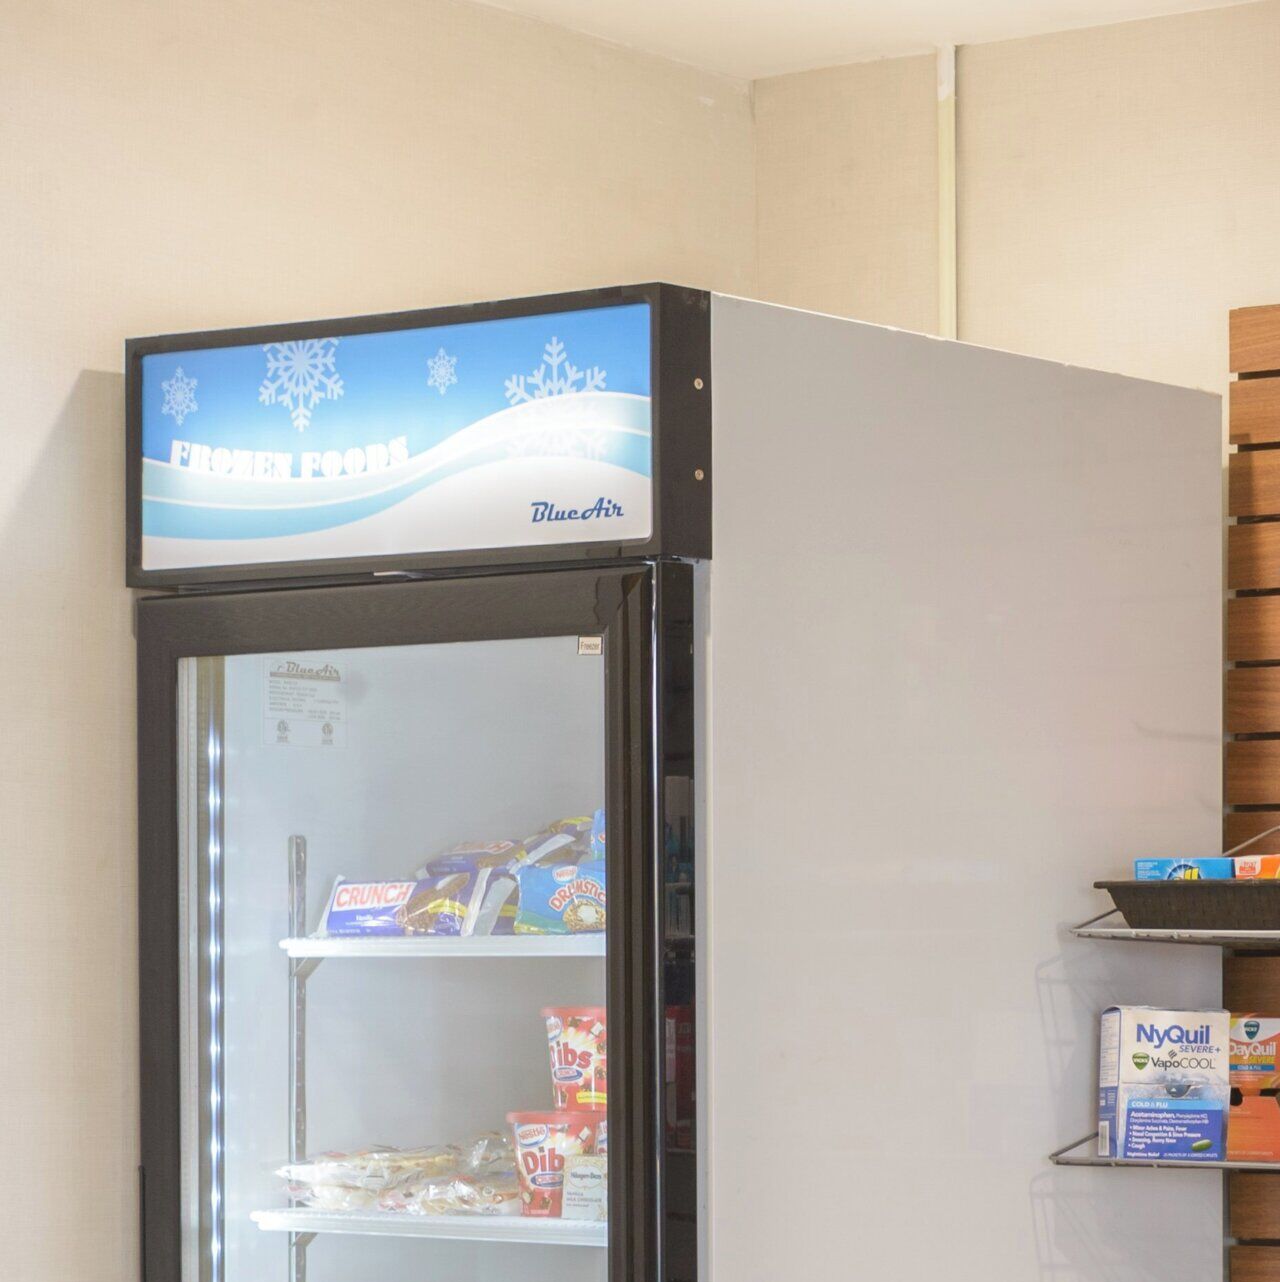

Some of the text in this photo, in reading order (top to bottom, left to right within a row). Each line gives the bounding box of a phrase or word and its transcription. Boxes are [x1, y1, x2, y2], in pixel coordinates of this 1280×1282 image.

[170, 436, 409, 478] FROZEN FOODS
[335, 883, 411, 907] CRUNCH
[550, 880, 606, 911] DRUMSTIC
[1136, 1024, 1210, 1048] NyQuil
[1230, 1042, 1276, 1059] DayQuil
[1151, 1057, 1215, 1070] VapoCOOL
[523, 1147, 564, 1174] Dib
